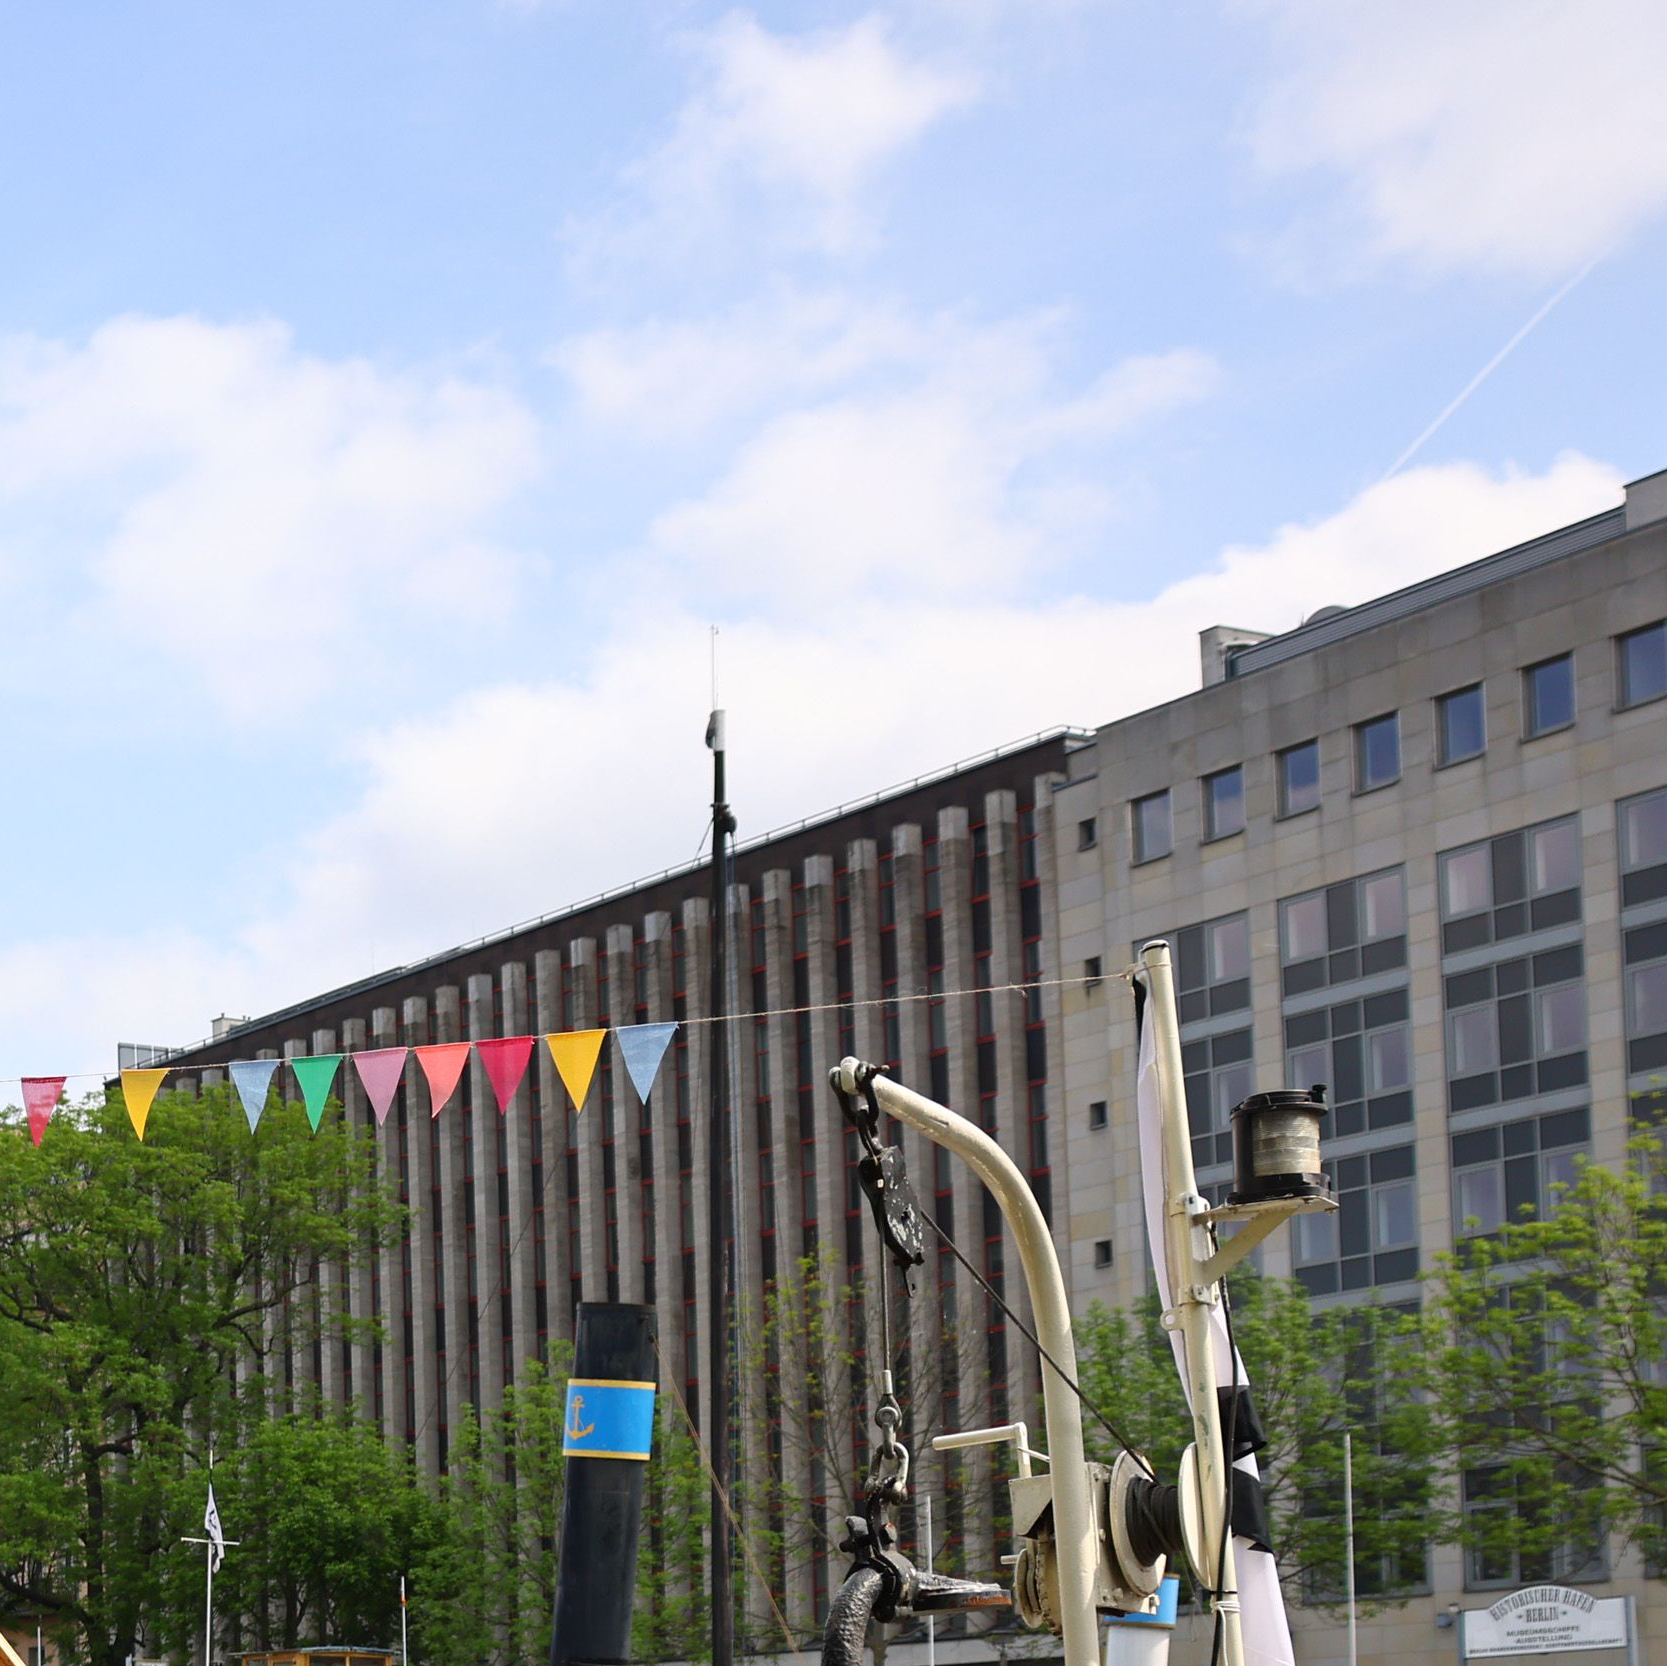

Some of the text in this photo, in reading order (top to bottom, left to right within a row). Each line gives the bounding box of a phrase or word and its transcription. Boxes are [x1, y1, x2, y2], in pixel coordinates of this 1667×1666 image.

[1489, 1588, 1599, 1621] HISTORISCHER HAFEN
[1524, 1606, 1560, 1623] BERLIN
